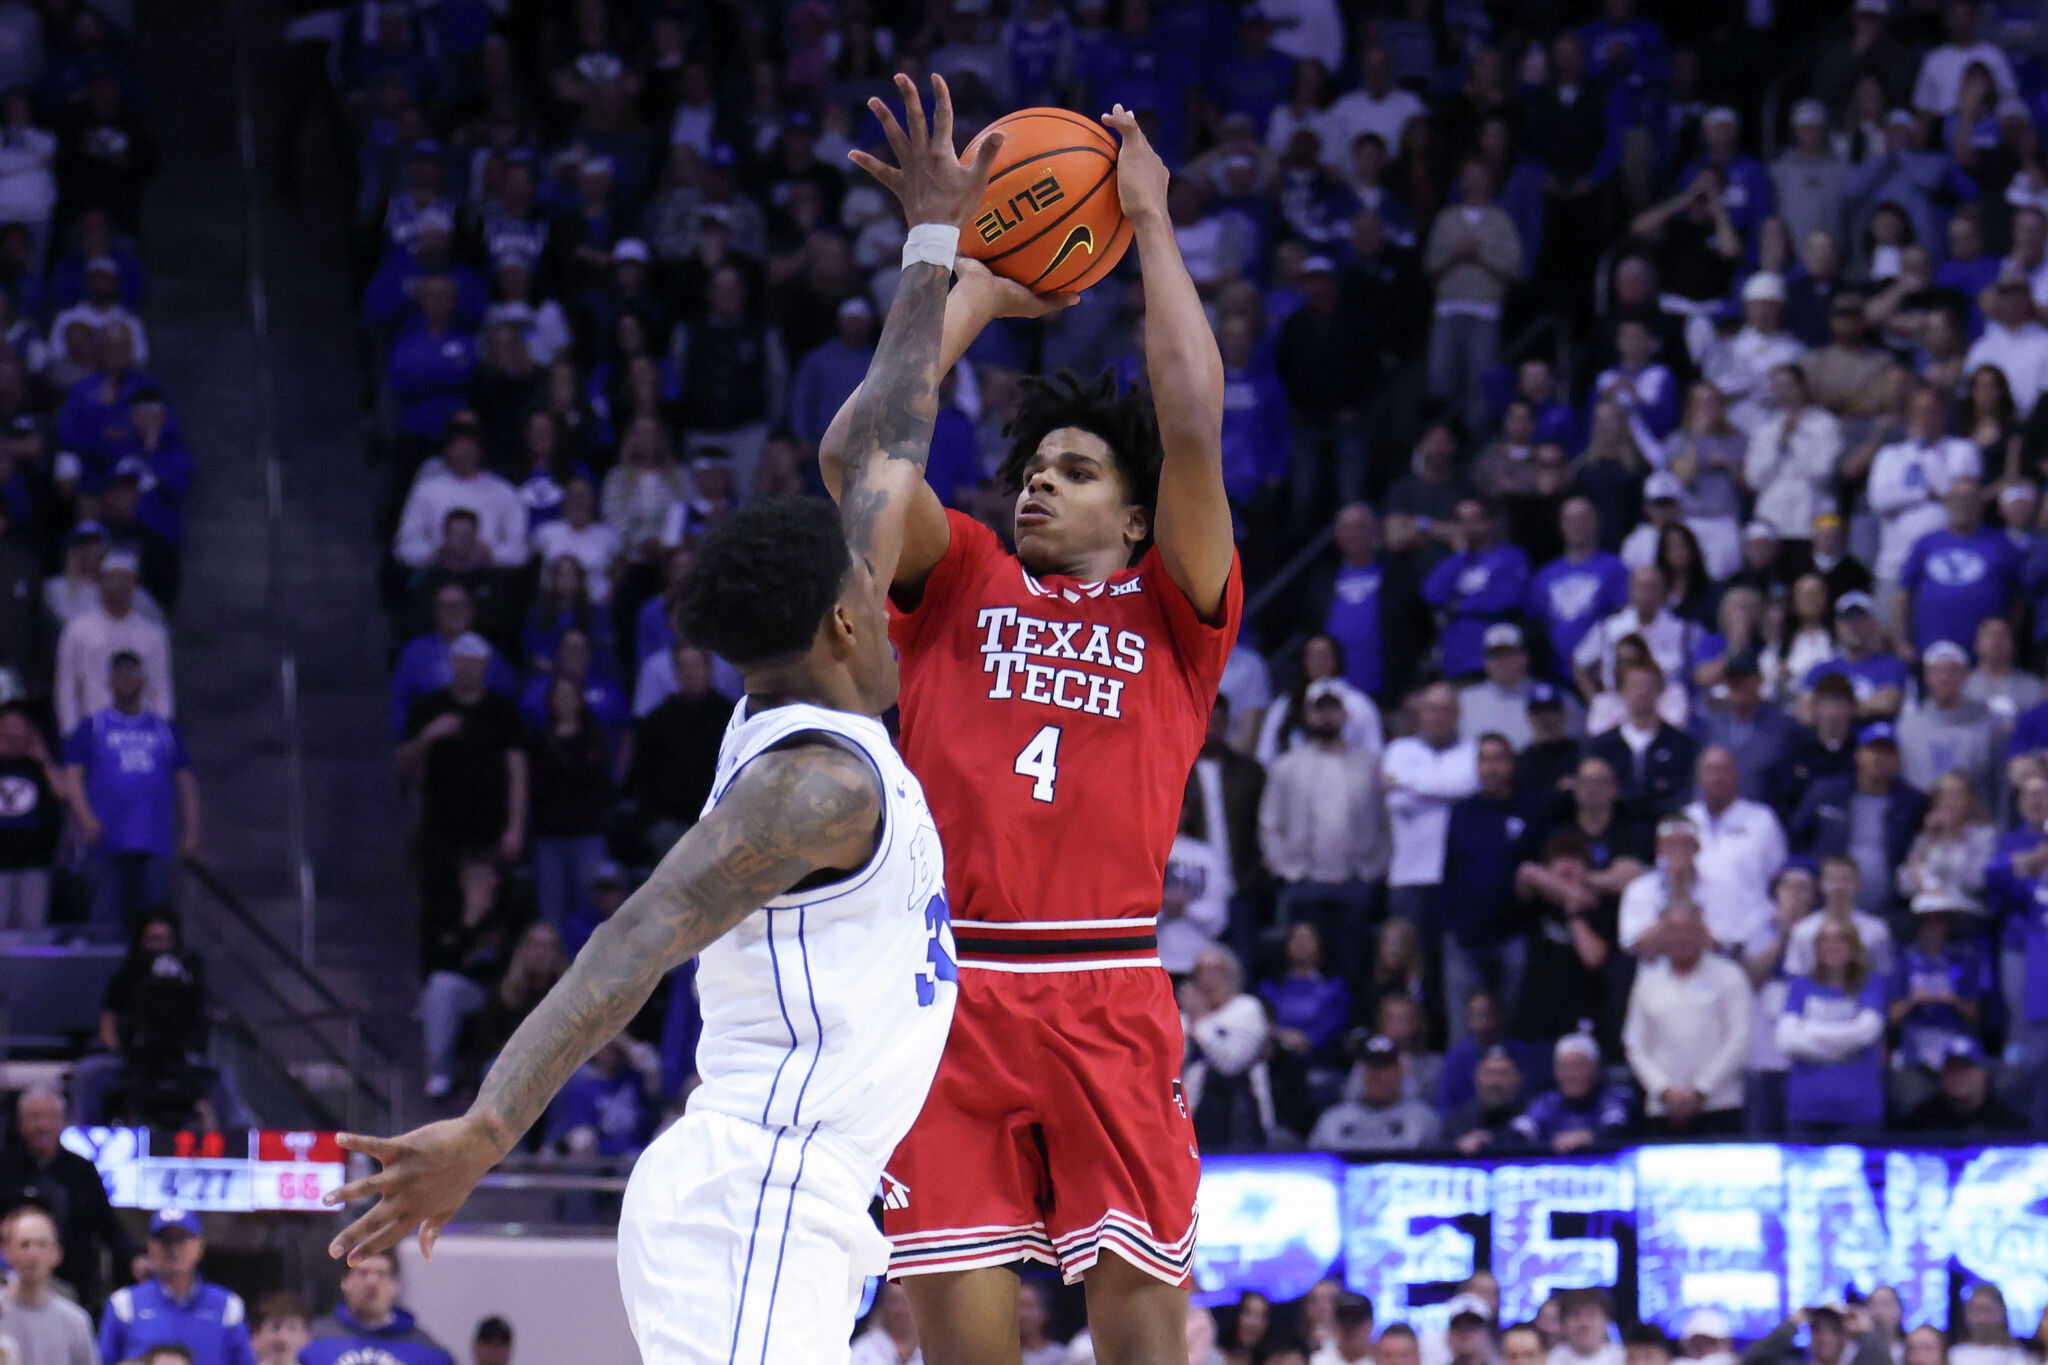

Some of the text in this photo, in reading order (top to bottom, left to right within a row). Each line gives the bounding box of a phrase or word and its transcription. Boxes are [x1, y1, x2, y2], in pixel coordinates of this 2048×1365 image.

[974, 174, 1065, 246] ELITE
[976, 606, 1146, 675] TEXAS
[983, 651, 1125, 719] TECH
[1014, 723, 1063, 804] 4
